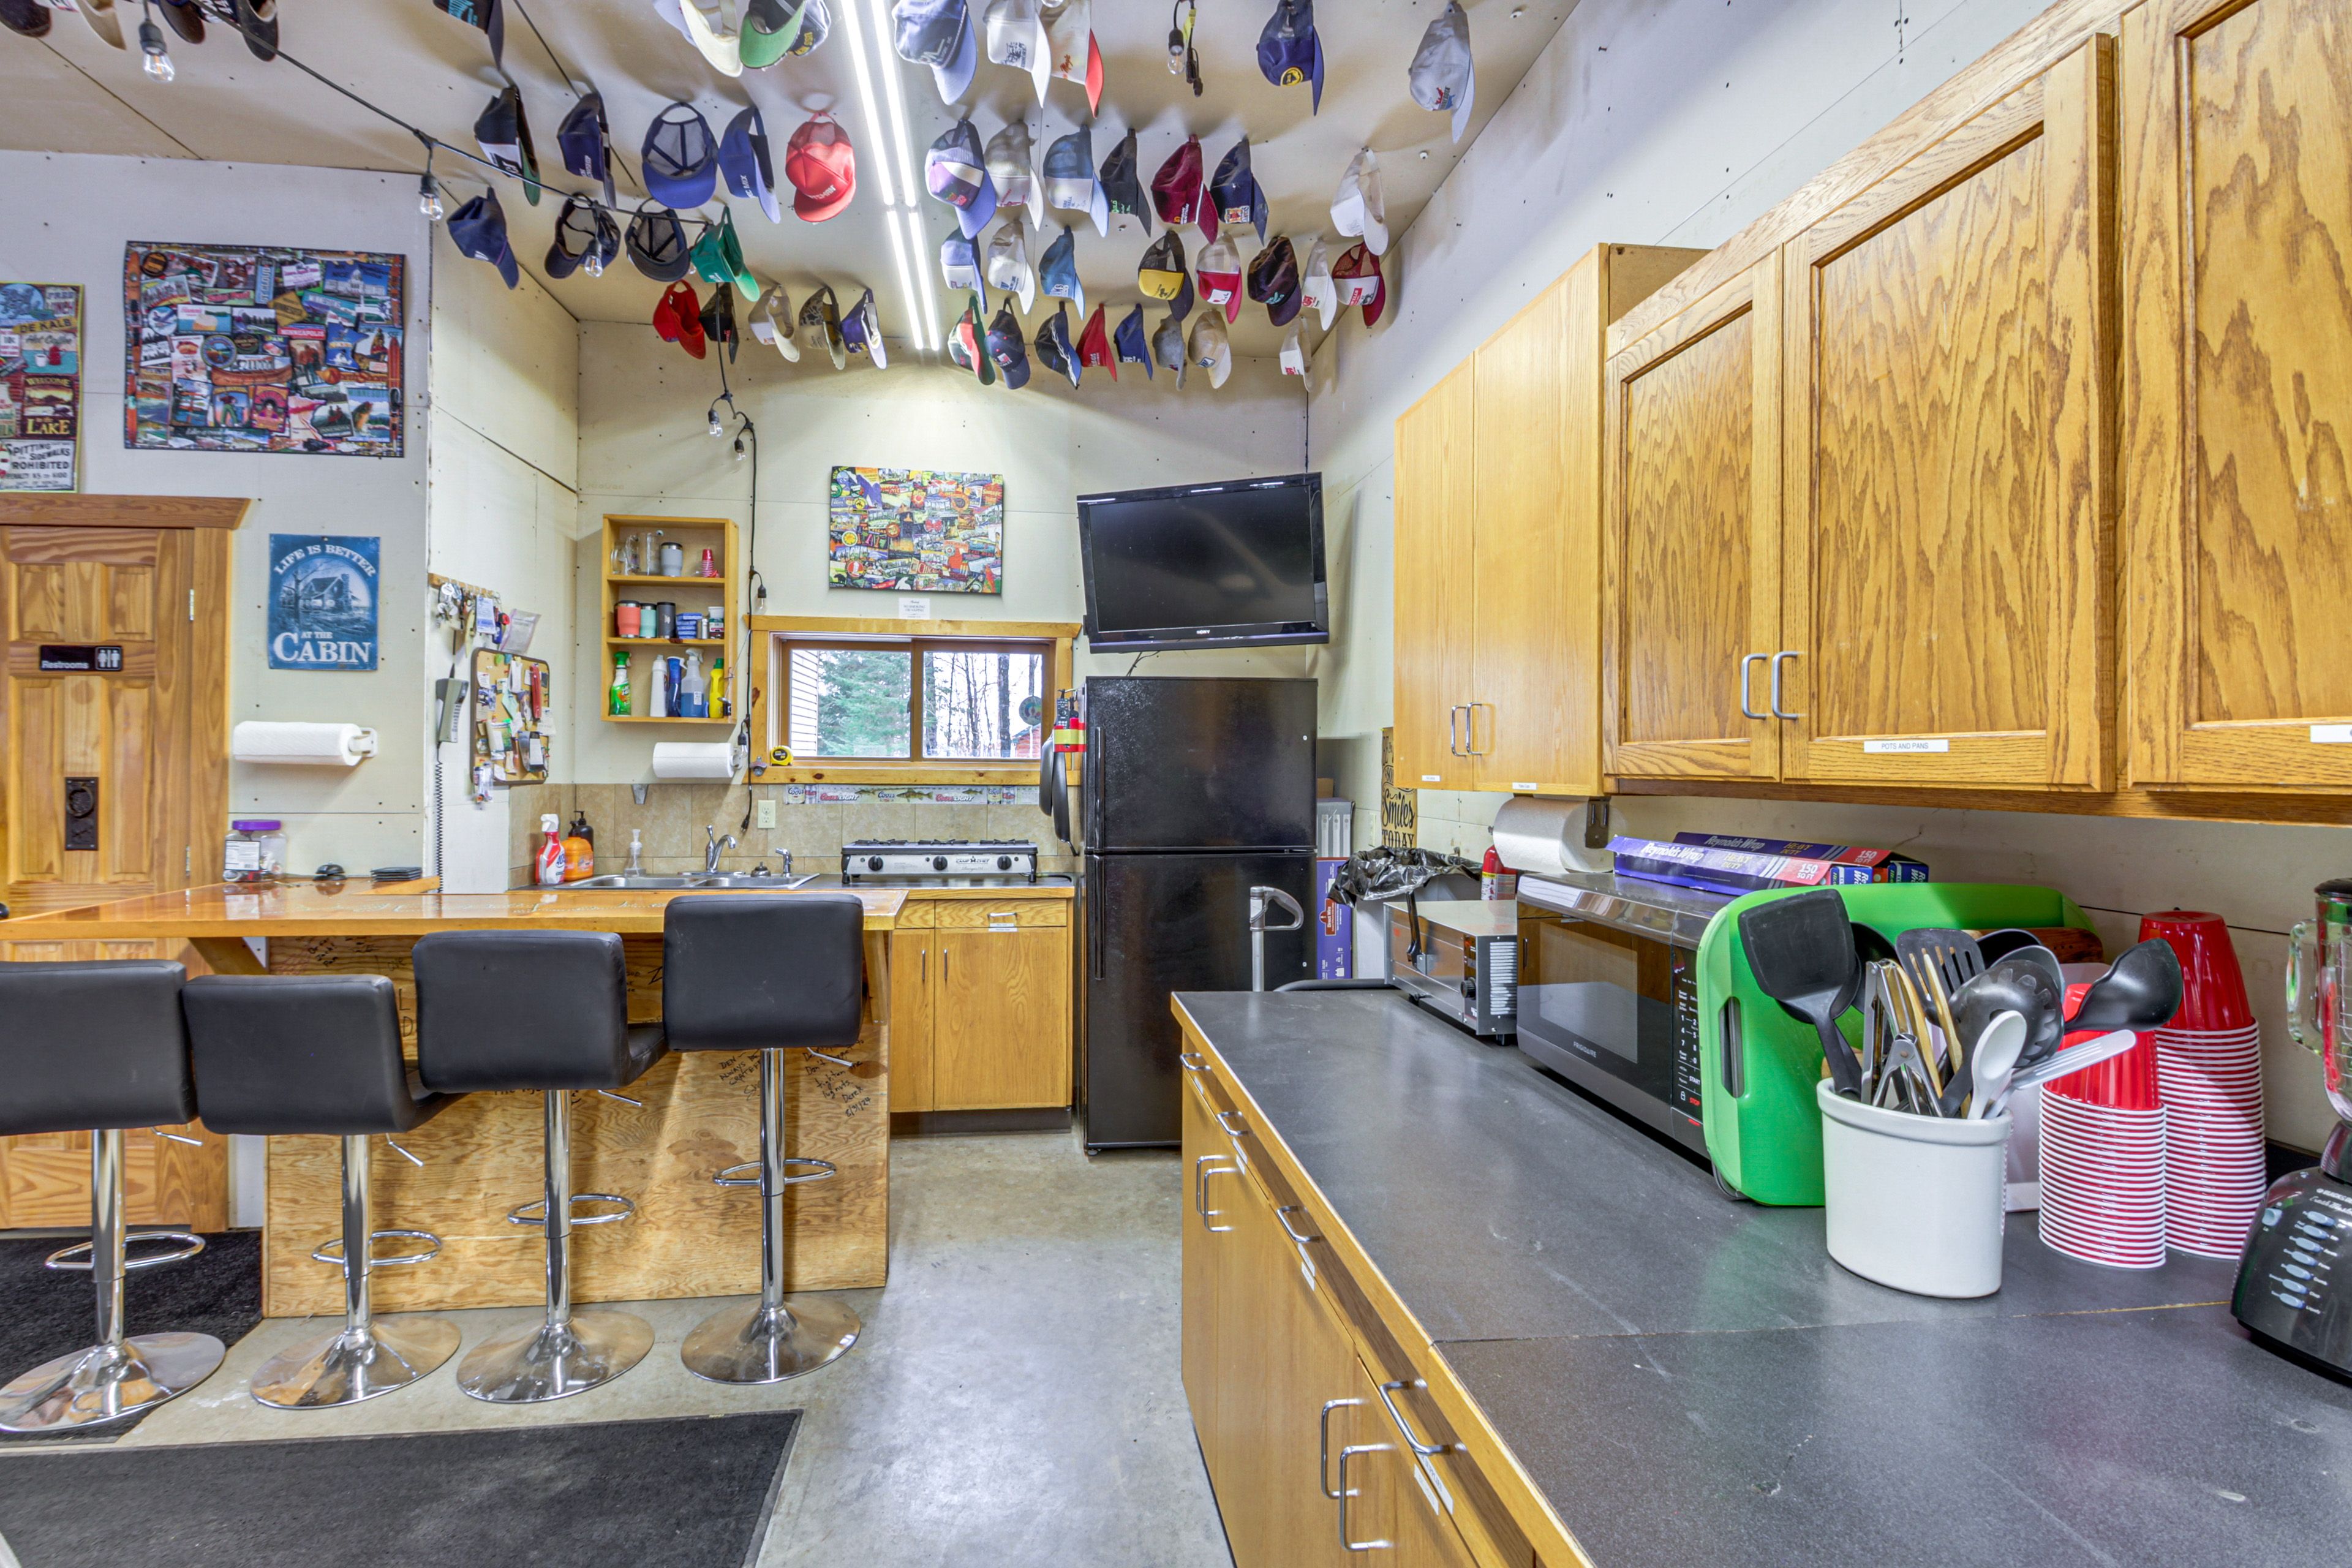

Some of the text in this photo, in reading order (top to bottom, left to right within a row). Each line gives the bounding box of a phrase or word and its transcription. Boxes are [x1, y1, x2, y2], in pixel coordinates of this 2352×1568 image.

[740, 175, 751, 189] MIX
[261, 266, 271, 291] CLOUD
[40, 318, 72, 330] KALB
[26, 377, 71, 386] WELCOME
[26, 419, 71, 435] LAKE
[6, 443, 51, 456] SPITTING
[29, 448, 70, 461] SIDEWALKS
[12, 461, 70, 470] ROHIBITED
[273, 544, 377, 577] LIFE IS BETTER
[273, 632, 372, 663] CABIN
[41, 660, 89, 669] Restrooms
[1382, 788, 1415, 829] Smiles
[1382, 829, 1414, 848] TODAY
[1705, 836, 1766, 850] Reynolds Wrap
[1641, 842, 1705, 862] Reynolds Wrap
[1784, 842, 1813, 851] HEAVY
[1724, 852, 1752, 863] HEAVY
[1857, 850, 1877, 859] 150
[1800, 863, 1818, 874] 150
[1574, 1041, 1597, 1058] FRIGIDAIRE
[719, 1061, 746, 1081] ALWAYS
[805, 1059, 826, 1075] Don't
[1689, 1076, 1701, 1085] START
[822, 1090, 836, 1099] lug
[842, 1085, 864, 1103] Derek
[1689, 1096, 1701, 1106] STOP
